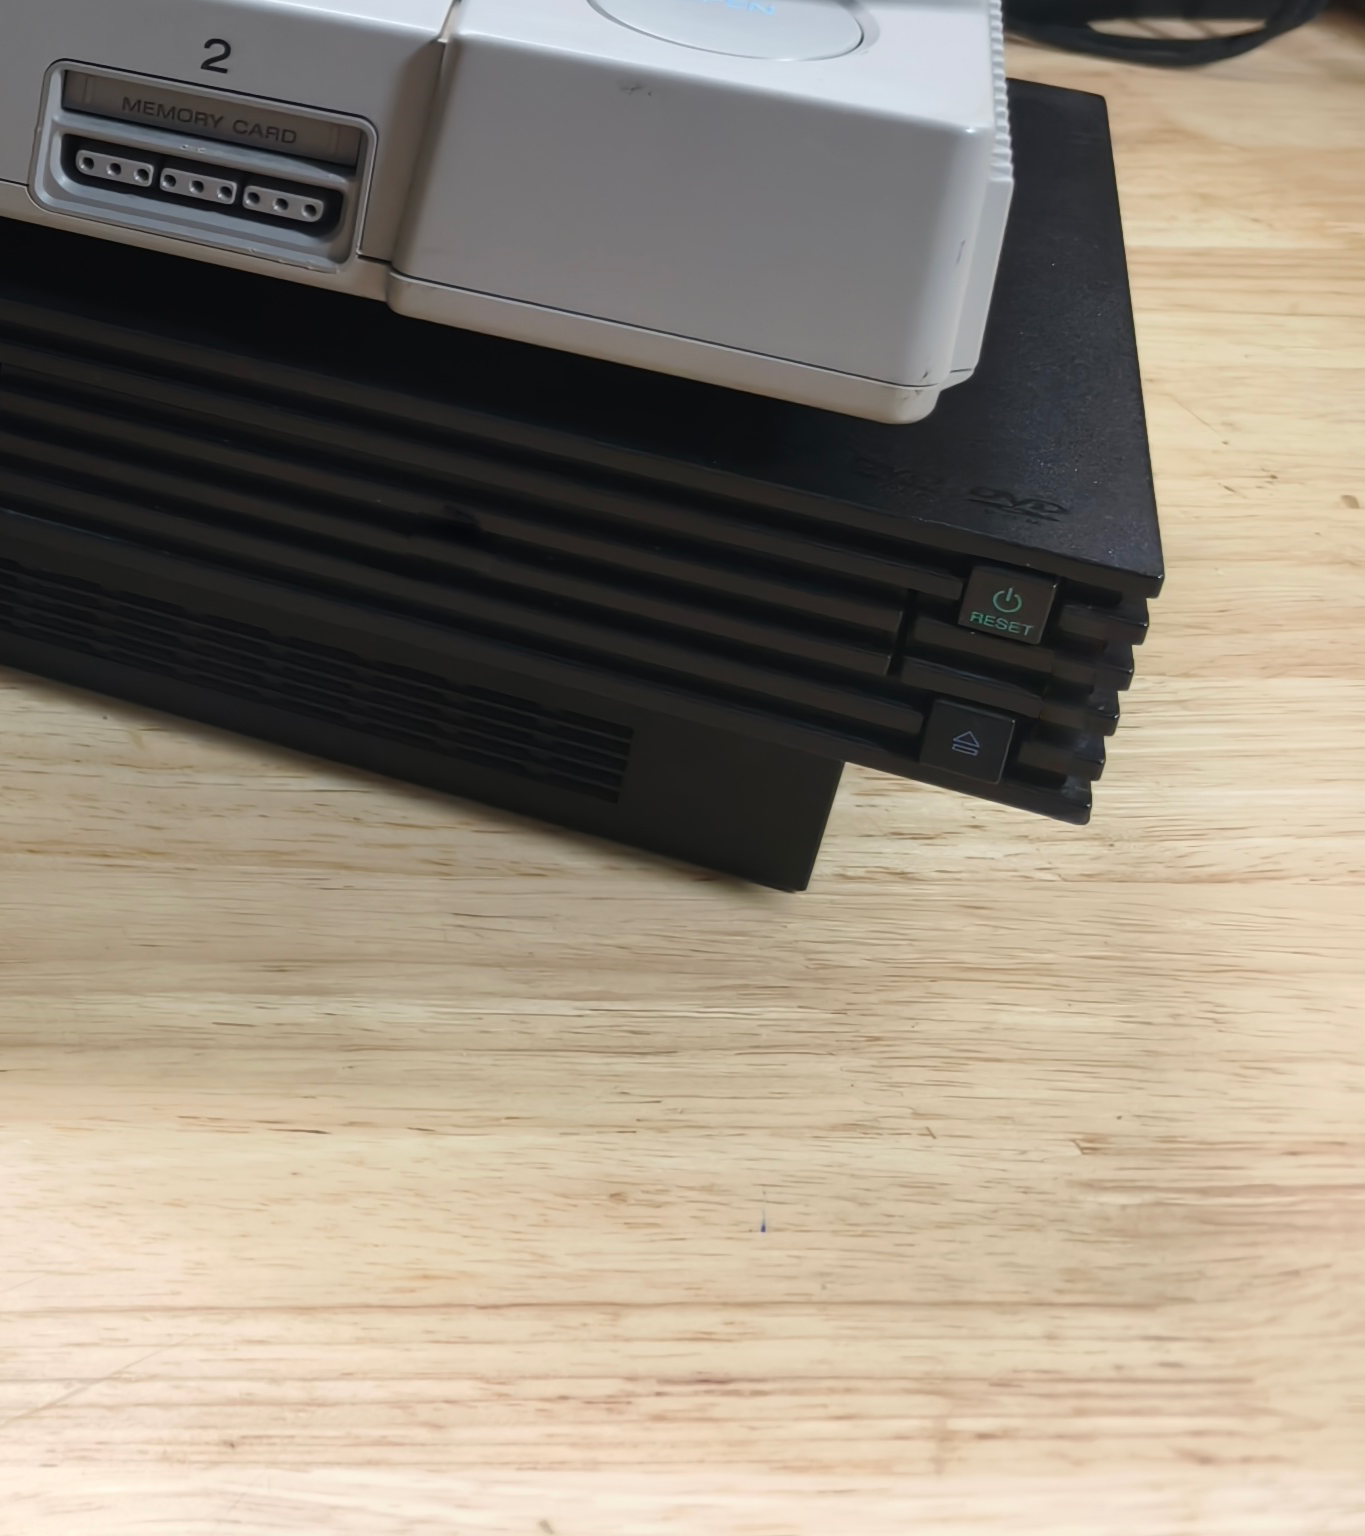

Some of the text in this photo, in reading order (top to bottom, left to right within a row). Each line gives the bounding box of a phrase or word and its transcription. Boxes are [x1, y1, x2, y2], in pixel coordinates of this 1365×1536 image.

[200, 38, 232, 74] 2
[121, 96, 297, 144] MEMORY CARD
[970, 611, 1035, 637] RESET
